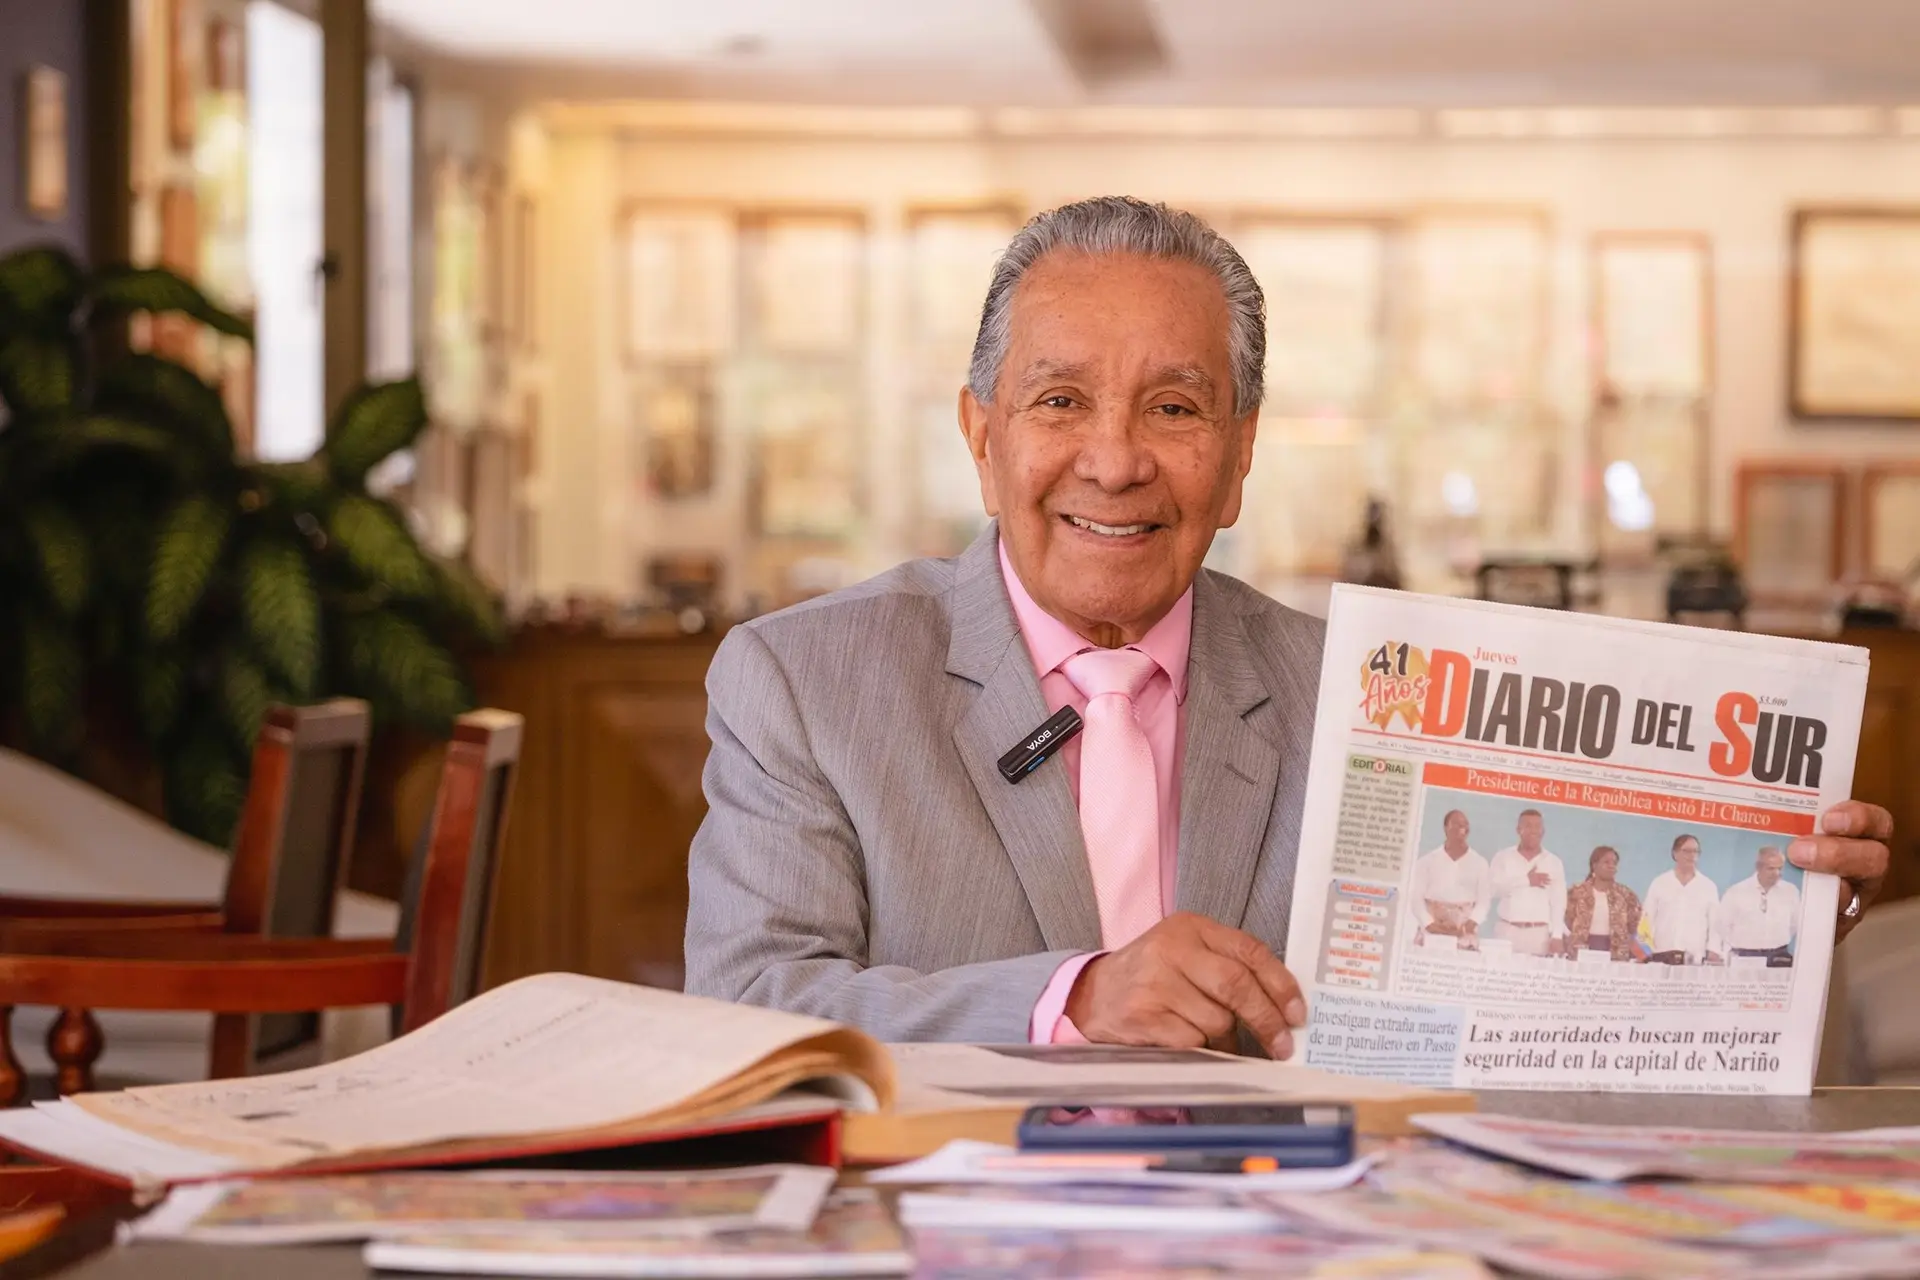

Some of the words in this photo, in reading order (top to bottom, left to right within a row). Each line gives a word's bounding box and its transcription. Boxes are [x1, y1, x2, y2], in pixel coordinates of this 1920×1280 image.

[1369, 642, 1409, 676] 41
[1472, 646, 1518, 665] Jueves
[1360, 674, 1430, 720] Años
[1421, 648, 1621, 759] DIARIO
[1631, 698, 1695, 752] DEL
[1708, 691, 1828, 788] SUR
[1026, 729, 1053, 751] BOYA
[1352, 758, 1407, 774] EDITORIAL
[1467, 769, 1541, 795] Presidente
[1543, 780, 1561, 798] de
[1564, 782, 1578, 800] la
[1582, 785, 1652, 811] República
[1656, 795, 1697, 816] visitó
[1700, 801, 1715, 818] El
[1720, 804, 1771, 826] Charco
[1319, 992, 1362, 1007] Tragedia
[1364, 1000, 1377, 1008] en
[1313, 1005, 1371, 1032] Investigan
[1374, 1017, 1416, 1034] extraña
[1418, 1021, 1458, 1036] muerte
[1309, 1028, 1324, 1046] de
[1327, 1034, 1342, 1047] un
[1345, 1035, 1404, 1053] patrullero
[1406, 1040, 1420, 1052] en
[1424, 1037, 1456, 1053] Pasto
[1469, 1024, 1503, 1043] Las
[1509, 1025, 1622, 1044] autoridades
[1628, 1026, 1695, 1044] buscan
[1702, 1026, 1782, 1049] mejorar
[1463, 1049, 1557, 1074] seguridad
[1563, 1053, 1584, 1069] en
[1590, 1049, 1608, 1069] la
[1614, 1050, 1679, 1076] capital
[1684, 1050, 1707, 1071] de
[1713, 1050, 1780, 1073] Nariño
